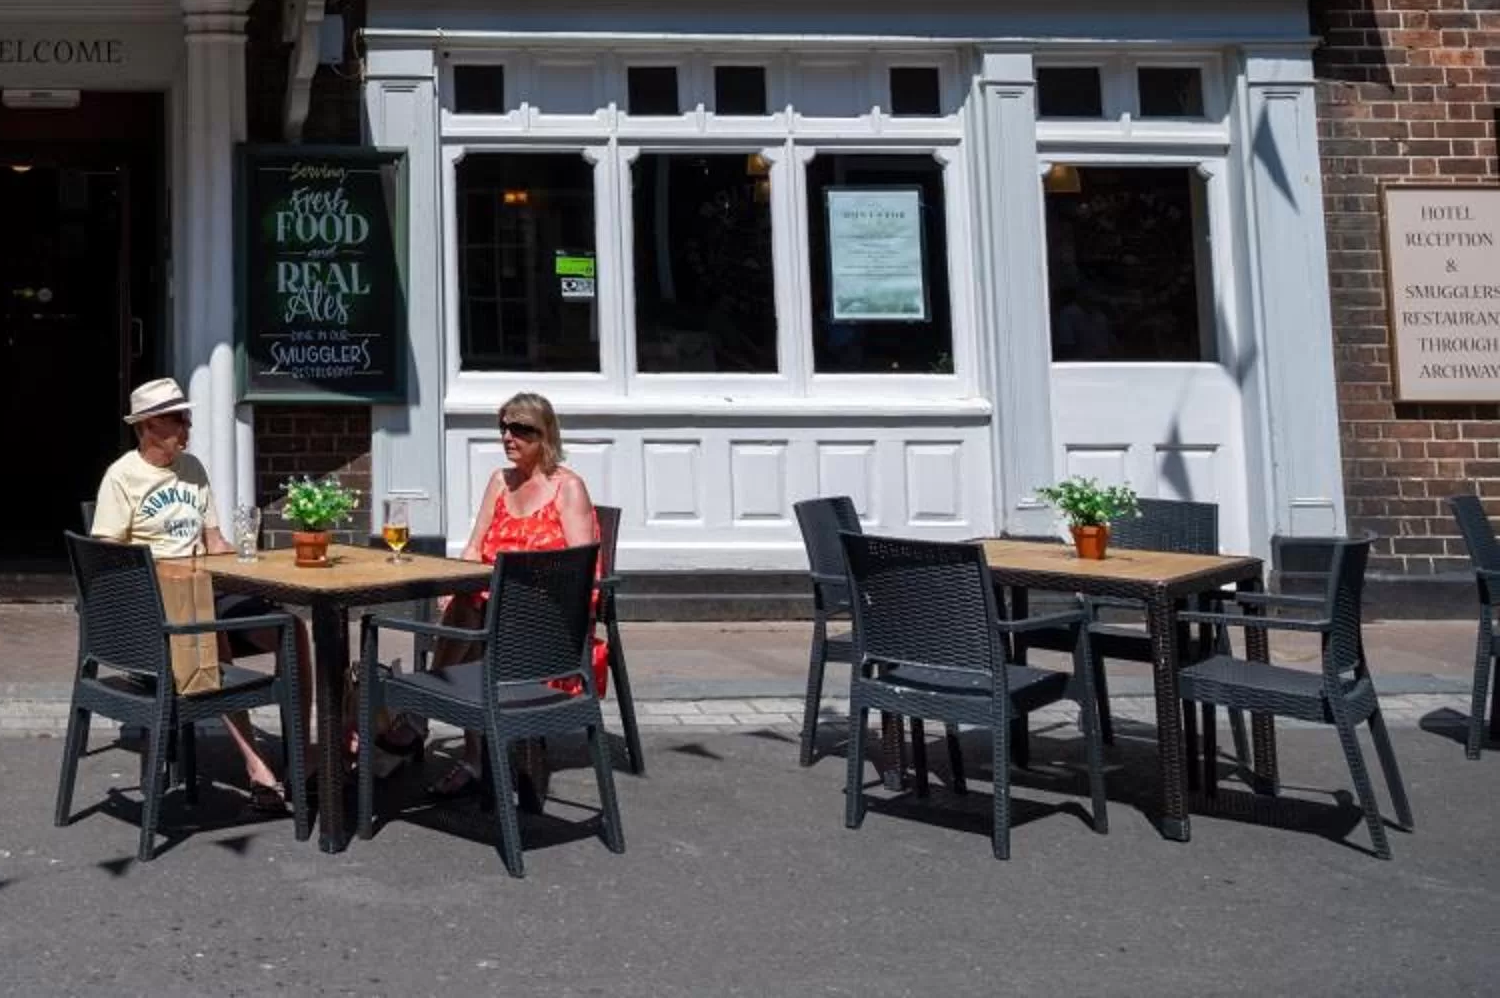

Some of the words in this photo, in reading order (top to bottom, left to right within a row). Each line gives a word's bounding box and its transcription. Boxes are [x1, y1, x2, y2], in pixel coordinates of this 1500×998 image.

[290, 162, 348, 183] Serving
[291, 186, 349, 217] Fresh
[1420, 205, 1475, 221] HOTEL
[275, 211, 370, 244] FOOD
[1405, 232, 1493, 248] RECEPTION
[1445, 258, 1458, 273] &
[276, 261, 371, 295] REAL
[1404, 284, 1500, 299] SMUGGLERS
[285, 280, 350, 325] Ales
[1403, 311, 1500, 327] RESTAURAN
[1418, 337, 1499, 352] THROUGH
[270, 338, 371, 374] SMUGGLERS
